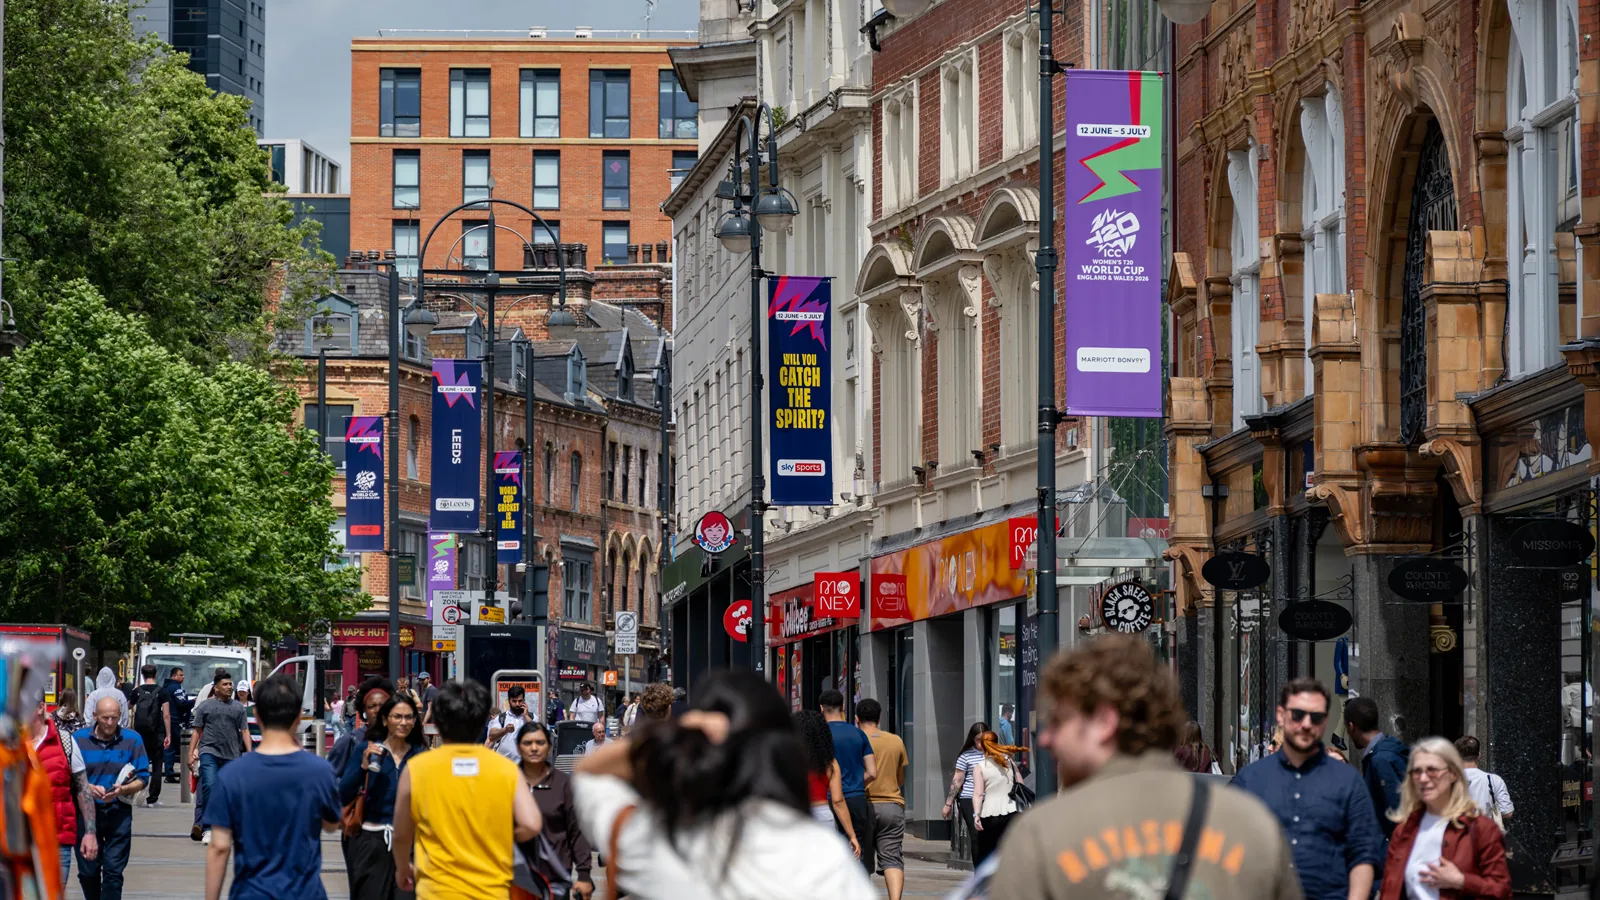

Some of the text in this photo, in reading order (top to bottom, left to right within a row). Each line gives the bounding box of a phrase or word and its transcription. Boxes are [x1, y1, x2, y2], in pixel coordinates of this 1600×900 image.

[1104, 248, 1122, 258] ICC
[1081, 265, 1144, 275] WORLD CUP
[782, 354, 817, 366] WILL YOU
[780, 366, 820, 387] CATCH
[788, 388, 811, 408] THE
[776, 408, 825, 430] SPIRIT?
[452, 429, 462, 464] LEEDS
[782, 464, 820, 472] sky sports
[498, 486, 518, 496] WORLD
[502, 495, 514, 504] CUP
[498, 502, 520, 512] CRICKET
[506, 512, 512, 520] IS
[502, 520, 516, 529] HERE
[1405, 572, 1450, 580] COUNTY
[1406, 581, 1450, 590] ARCADE
[1104, 587, 1122, 618] BLACK
[1122, 584, 1150, 604] SHEEP
[782, 596, 808, 638] Jollibee
[1294, 612, 1336, 620] COUNTY
[1118, 612, 1152, 634] COFFEE
[342, 628, 365, 636] VAPE
[368, 628, 386, 637] HUT
[574, 637, 596, 654] ZAM ZAM
